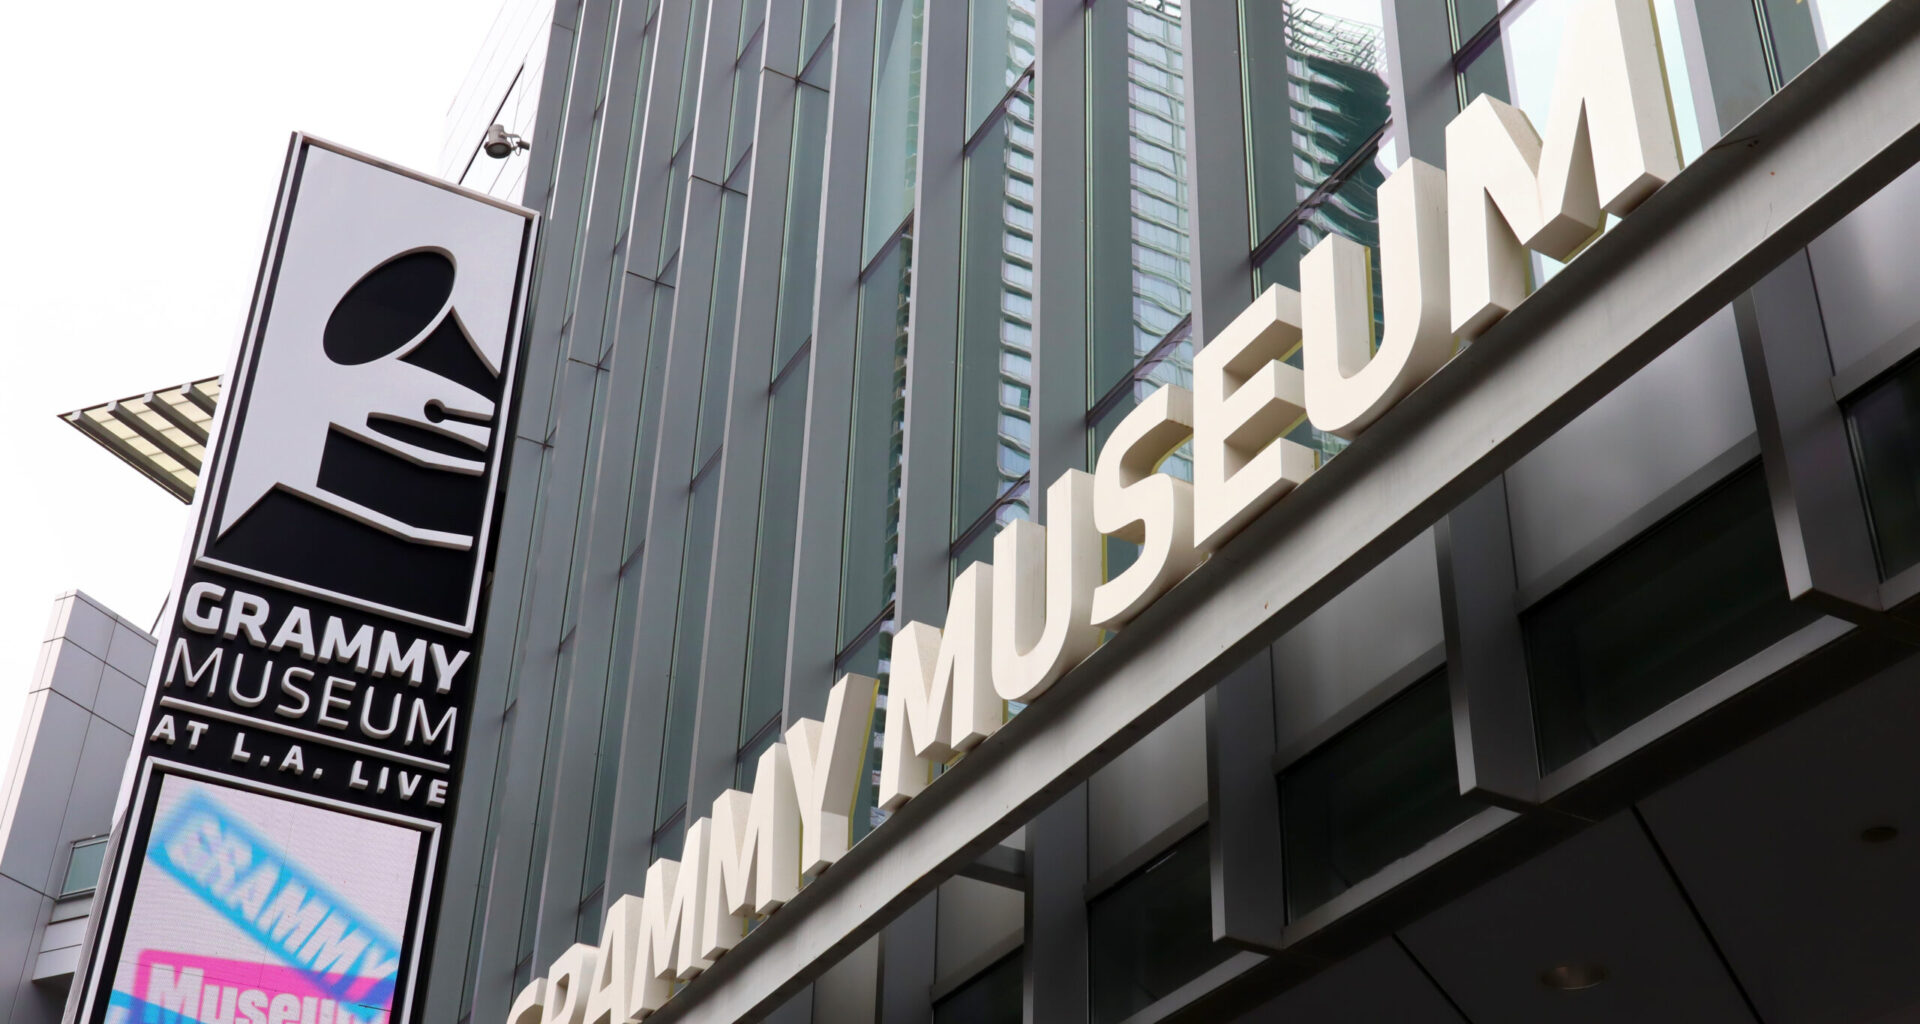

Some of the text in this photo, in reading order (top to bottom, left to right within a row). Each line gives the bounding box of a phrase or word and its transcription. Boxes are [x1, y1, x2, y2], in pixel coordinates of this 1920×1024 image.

[878, 0, 1685, 813] MUSEUM
[164, 637, 458, 755] MUSEUM
[182, 582, 470, 695] GRAMMY
[150, 714, 449, 807] AT L.A. LIVE
